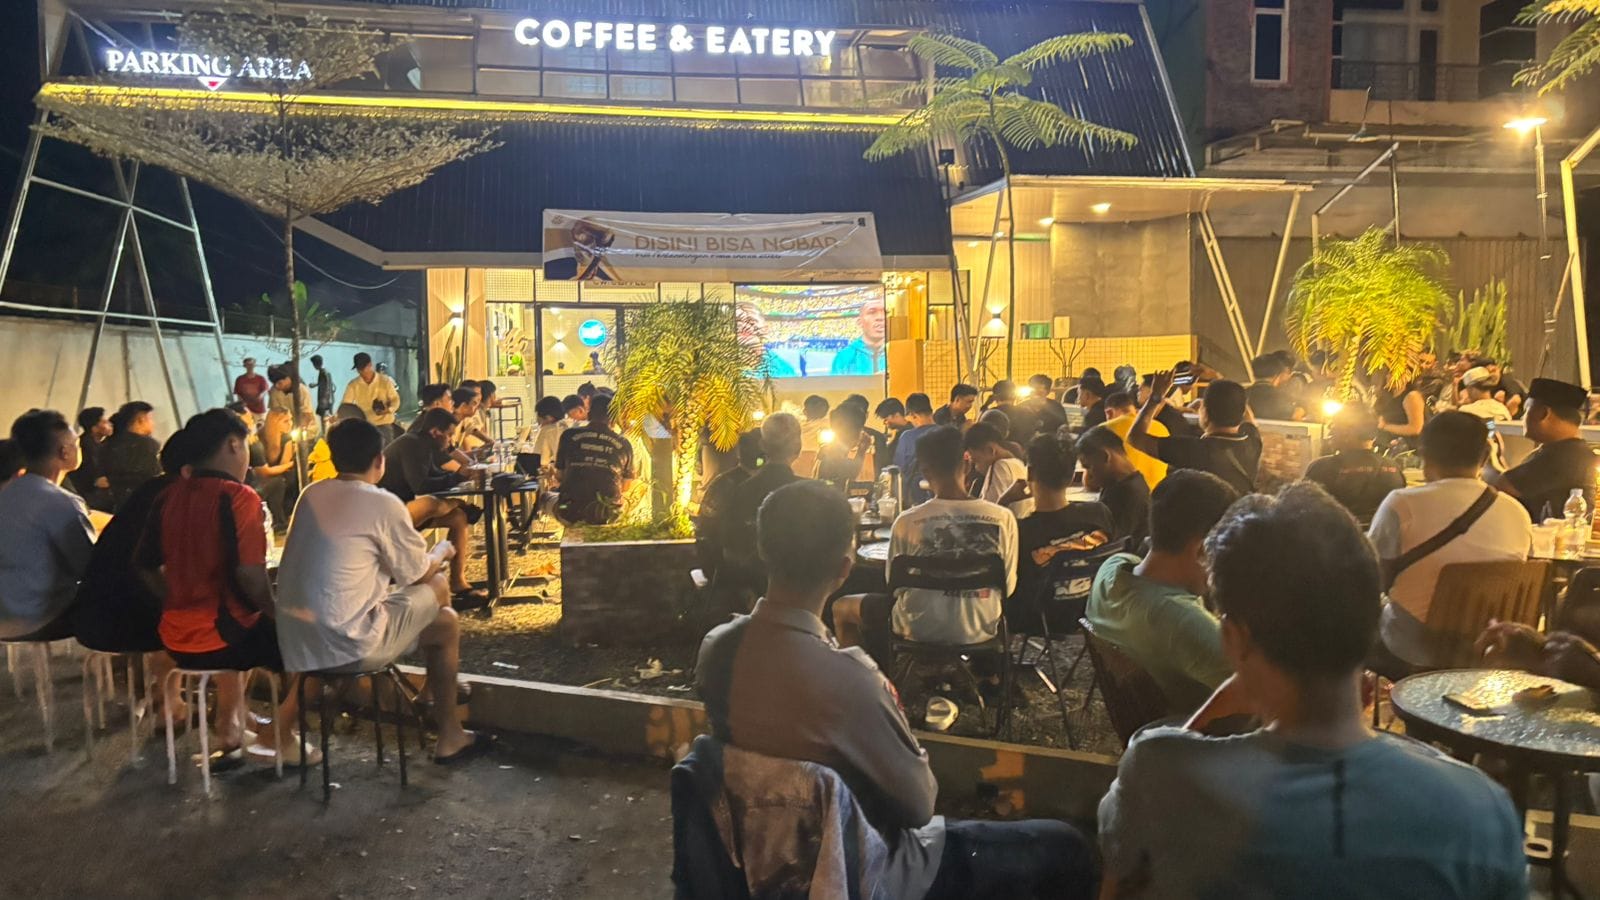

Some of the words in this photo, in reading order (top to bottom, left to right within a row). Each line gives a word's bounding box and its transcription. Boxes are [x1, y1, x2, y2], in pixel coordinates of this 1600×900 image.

[514, 18, 657, 50] COFFEE
[669, 24, 694, 52] &
[706, 26, 836, 56] EATERY
[106, 50, 231, 76] PARKING
[236, 56, 313, 80] AREA
[635, 236, 697, 250] DISINI
[706, 237, 755, 251] BISA
[762, 236, 840, 250] NOBAR
